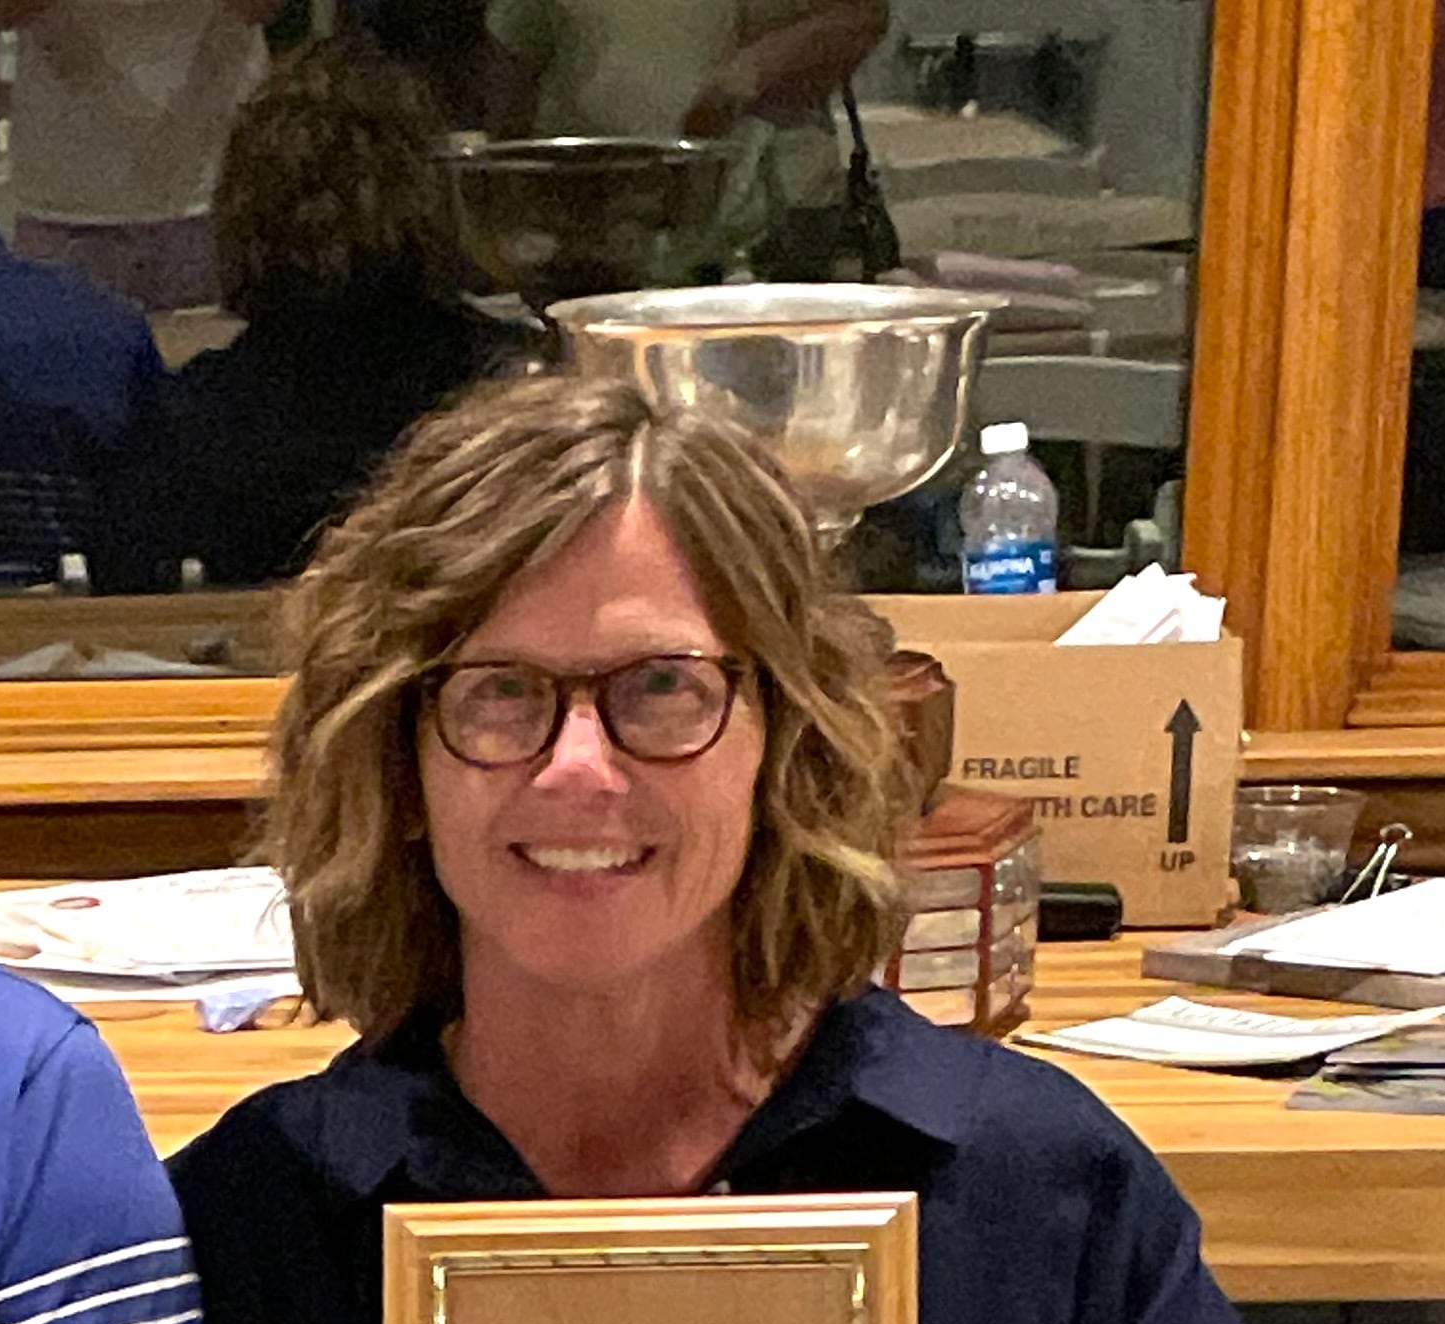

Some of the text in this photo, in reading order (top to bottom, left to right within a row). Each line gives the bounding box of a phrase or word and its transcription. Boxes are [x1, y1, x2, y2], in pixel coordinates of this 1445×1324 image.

[962, 756, 1081, 780] FRAGILE
[1080, 793, 1157, 818] CARE
[1160, 851, 1196, 873] UP
